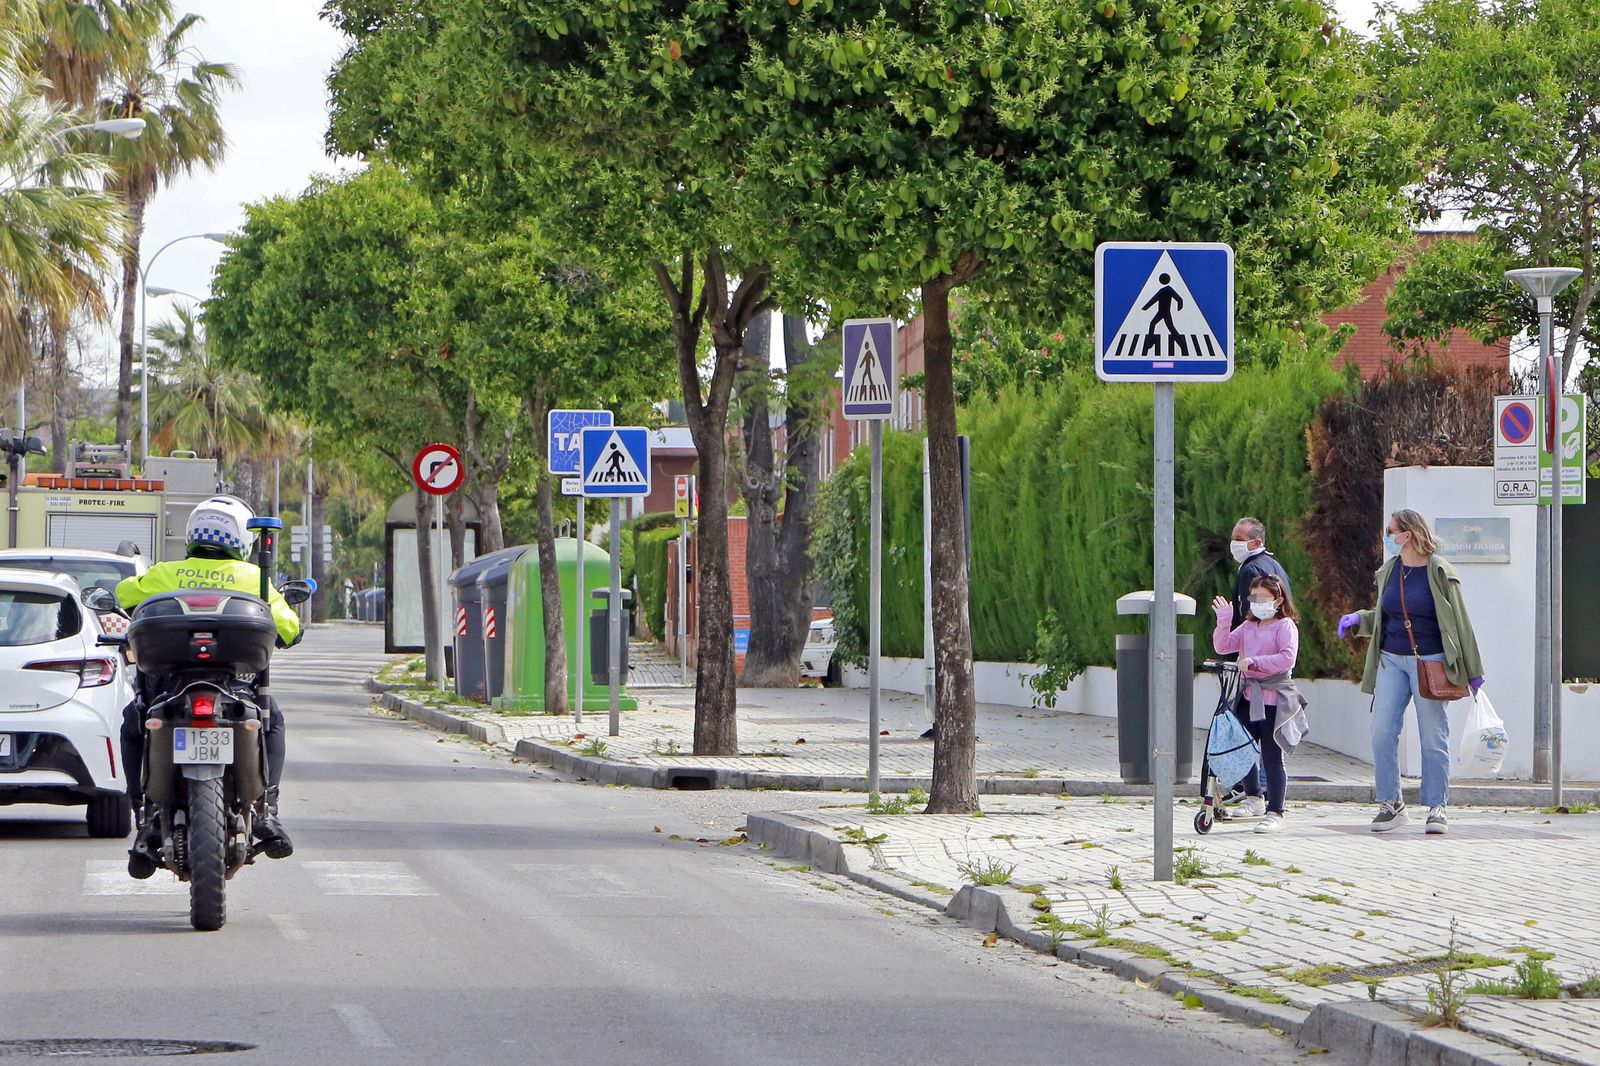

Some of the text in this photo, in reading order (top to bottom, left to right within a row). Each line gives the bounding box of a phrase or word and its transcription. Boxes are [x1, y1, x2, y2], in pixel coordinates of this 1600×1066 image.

[554, 433, 580, 451] TA
[1503, 483, 1531, 492] O.R.A.
[175, 568, 236, 584] POLICIA
[192, 731, 230, 745] 1533
[188, 747, 219, 761] JBM
